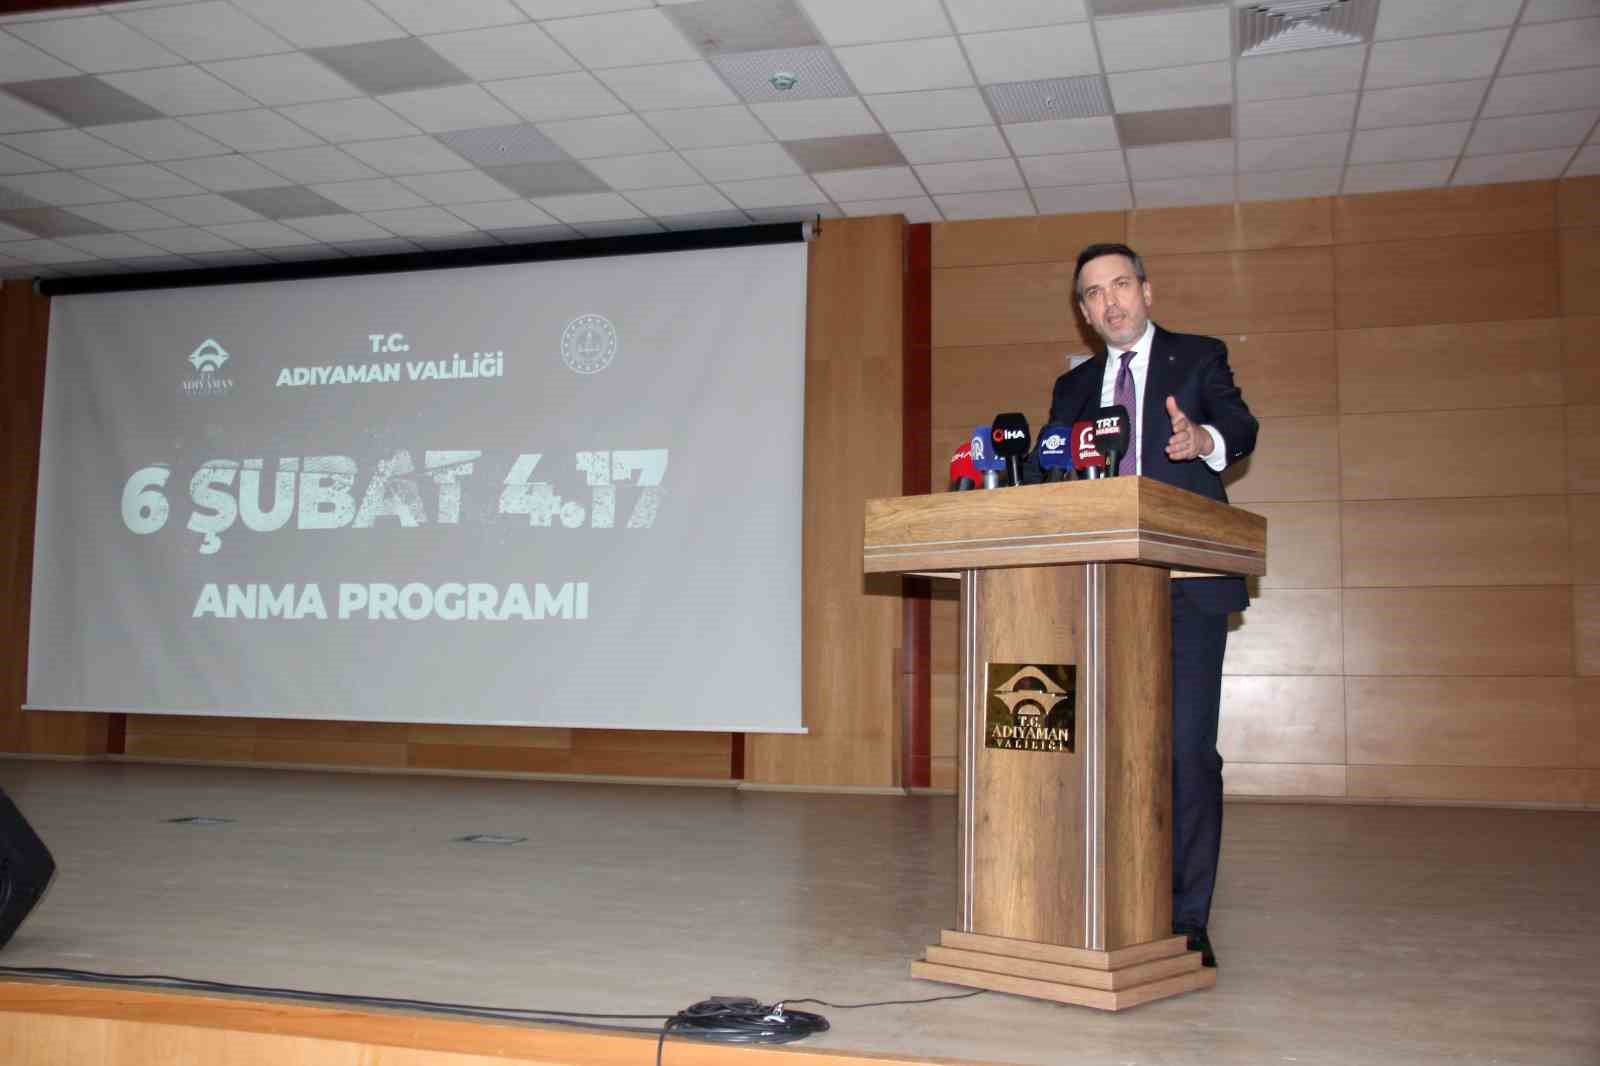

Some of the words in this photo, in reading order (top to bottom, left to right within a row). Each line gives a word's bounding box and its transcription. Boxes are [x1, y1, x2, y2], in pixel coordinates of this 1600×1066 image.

[368, 333, 410, 352] T.C.
[276, 362, 401, 387] ADIYAMAN
[405, 350, 503, 381] VALİLİĞİ
[1096, 416, 1120, 429] TRT
[120, 463, 171, 535] 6
[186, 450, 482, 555] ŞUBAT
[499, 449, 668, 528] 4.17
[192, 582, 328, 620] ANMA
[338, 582, 590, 621] PROGRAMI
[991, 724, 1069, 742] ADIYAMAN
